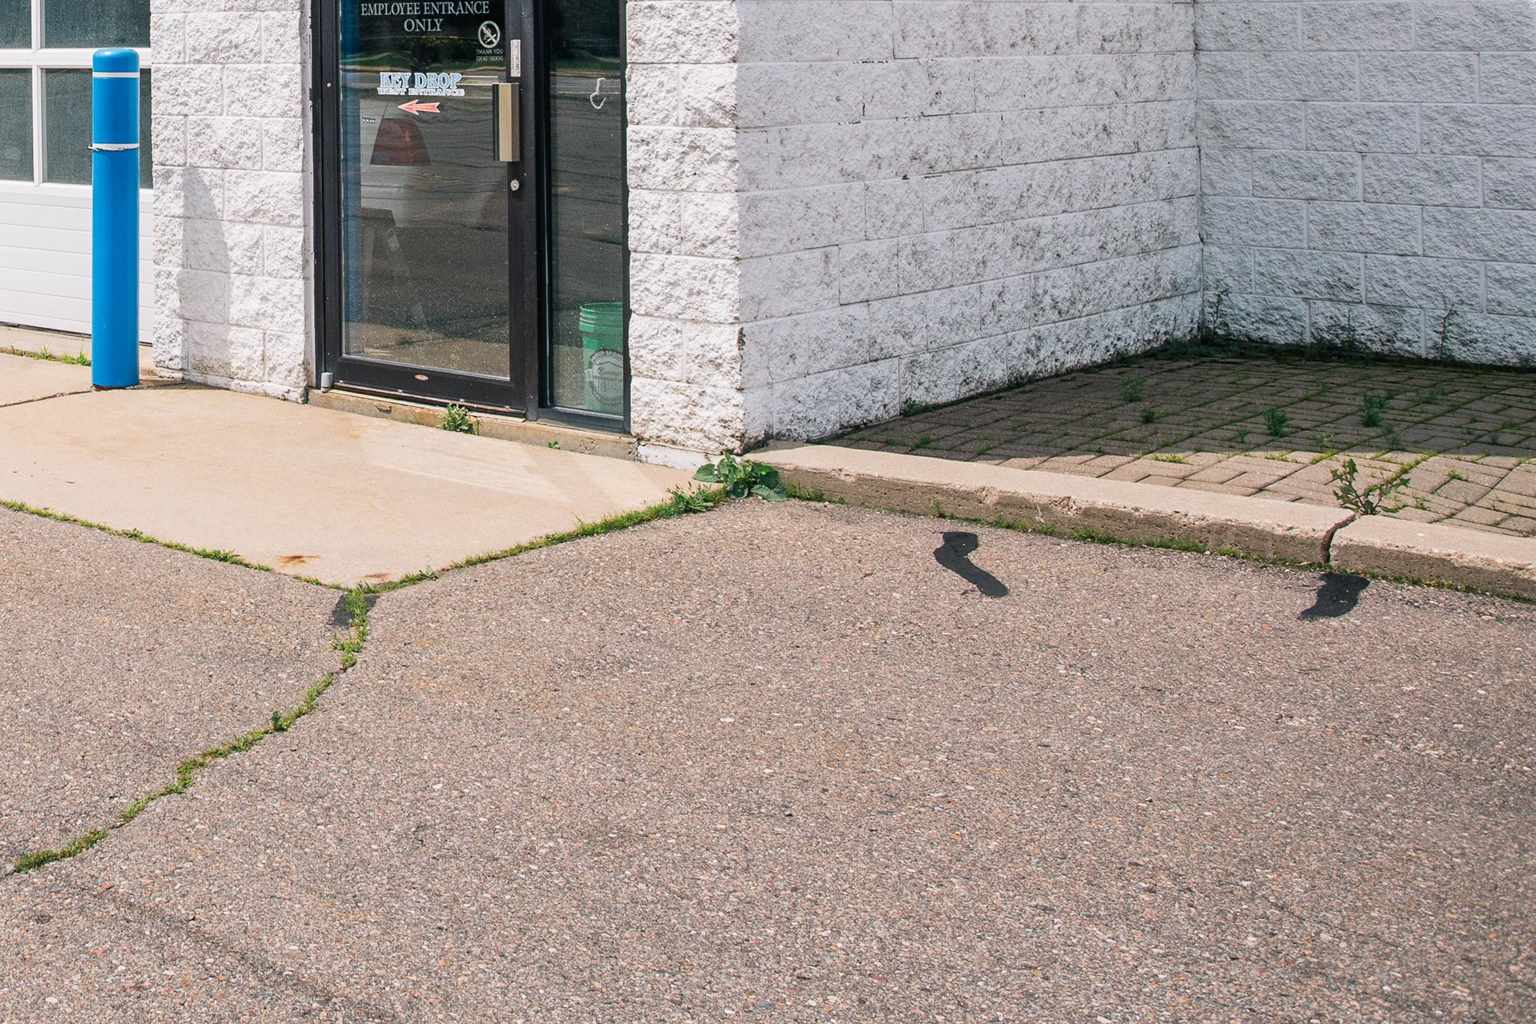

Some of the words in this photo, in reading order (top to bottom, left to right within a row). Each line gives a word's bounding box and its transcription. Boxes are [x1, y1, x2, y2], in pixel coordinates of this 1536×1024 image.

[361, 2, 421, 16] EMPLOYEE
[424, 1, 490, 16] ENTRANCE
[404, 18, 444, 32] ONLY
[380, 72, 412, 89] KEY
[414, 72, 463, 89] DROP
